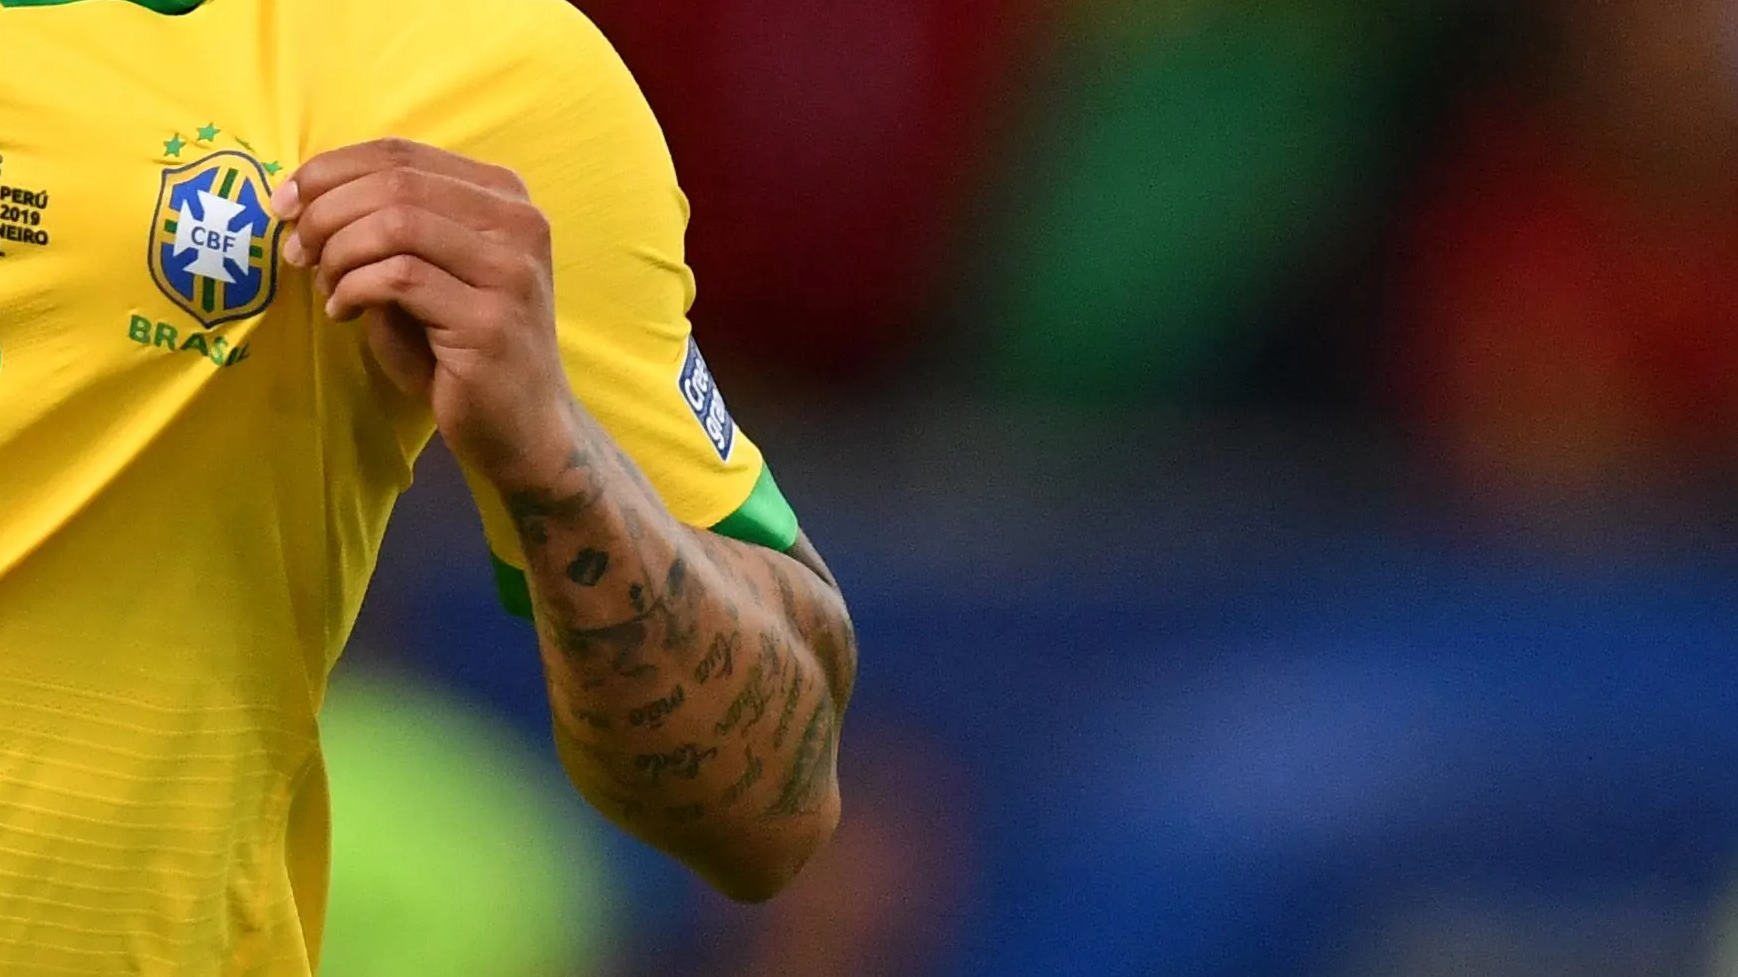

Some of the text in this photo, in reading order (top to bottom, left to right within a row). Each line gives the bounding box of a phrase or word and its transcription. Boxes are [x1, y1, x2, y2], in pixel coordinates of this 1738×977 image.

[0, 185, 49, 209] PERÚ
[0, 204, 40, 226] 2019
[191, 226, 236, 253] CBF
